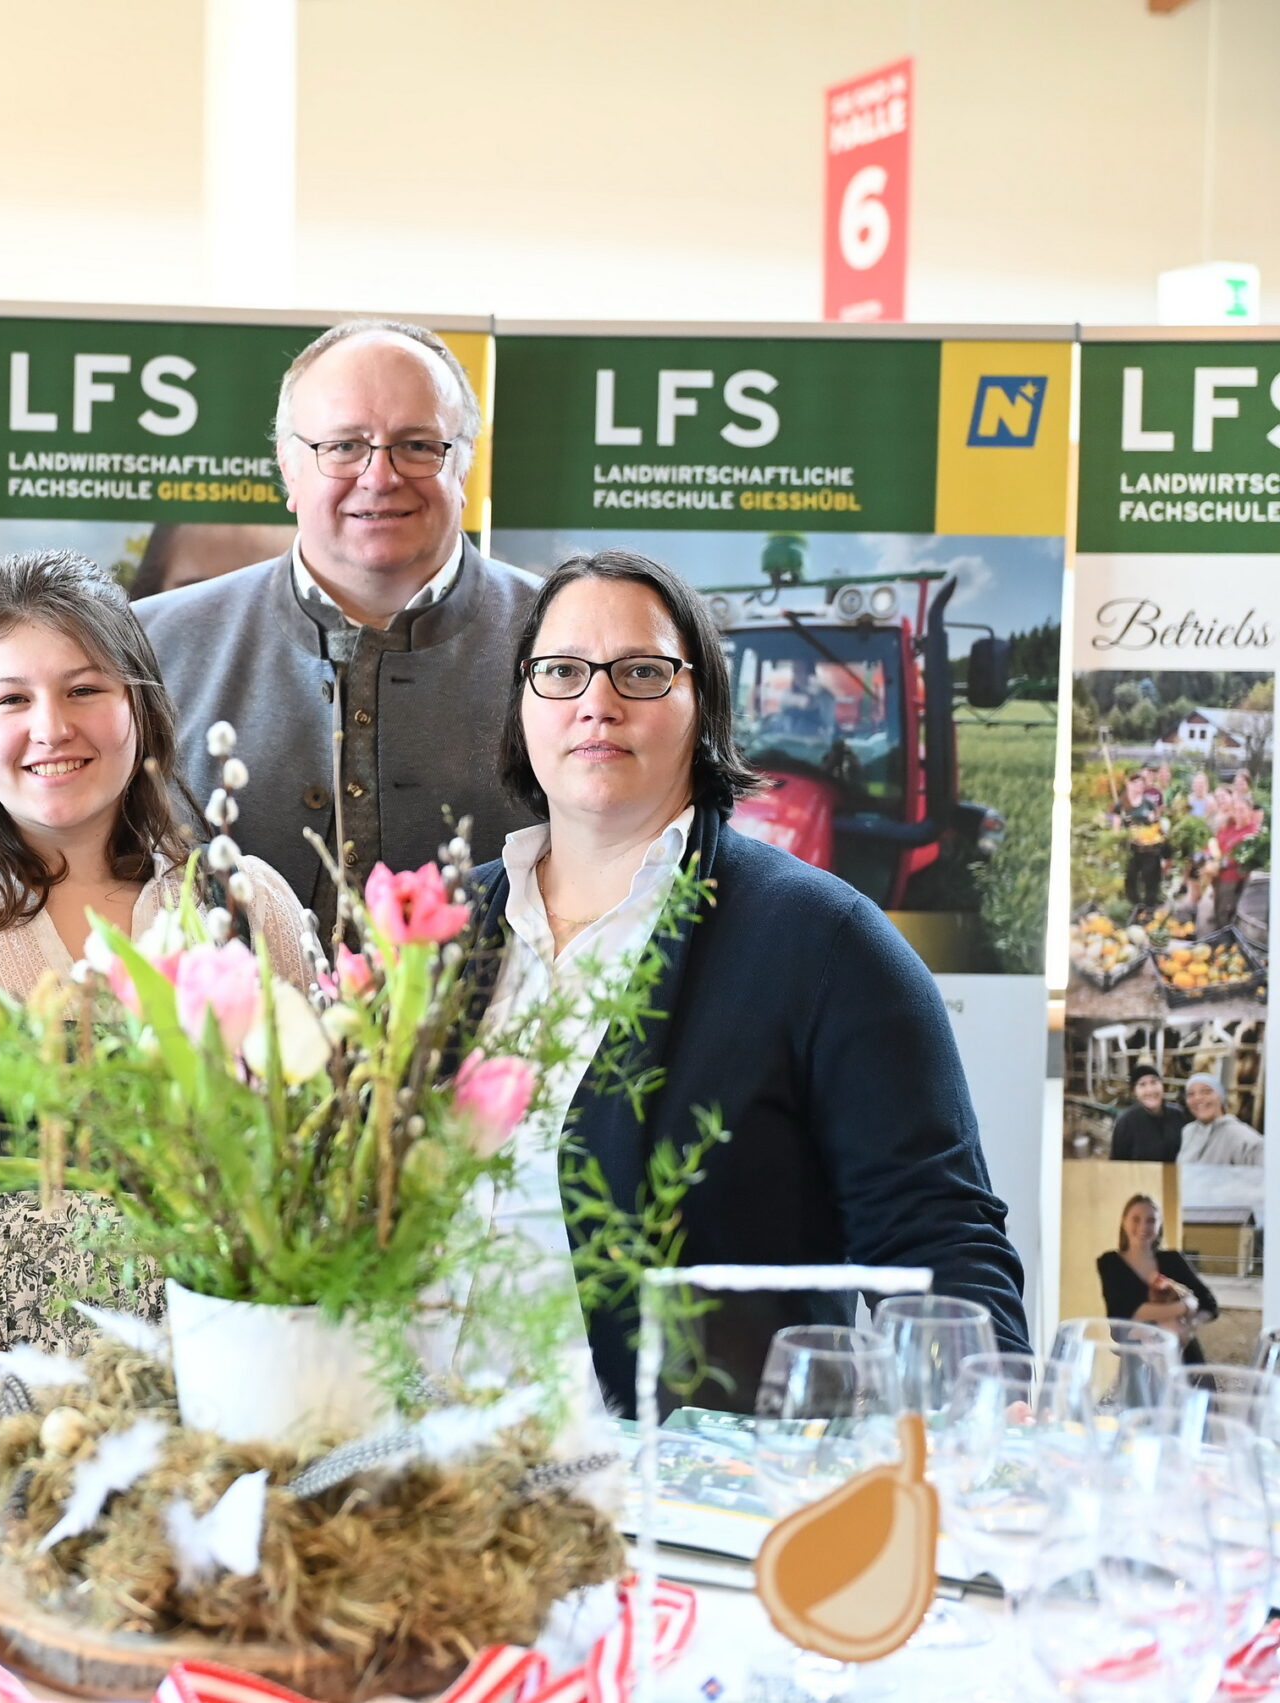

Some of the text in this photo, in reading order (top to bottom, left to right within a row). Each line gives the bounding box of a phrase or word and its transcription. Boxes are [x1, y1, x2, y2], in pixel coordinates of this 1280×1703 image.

[838, 164, 891, 271] 6
[9, 352, 199, 436] LFS
[595, 368, 780, 448] LFS
[8, 451, 273, 477] LANDWIRTSCHAFTLICHE
[593, 464, 854, 487] LANDWIRTSCHAFTLICHE
[8, 477, 281, 503] FACHSCHULE GIESSHÜBL
[593, 488, 862, 511] FACHSCHULE GIESSHÜBL
[1091, 596, 1274, 651] Betriebs
